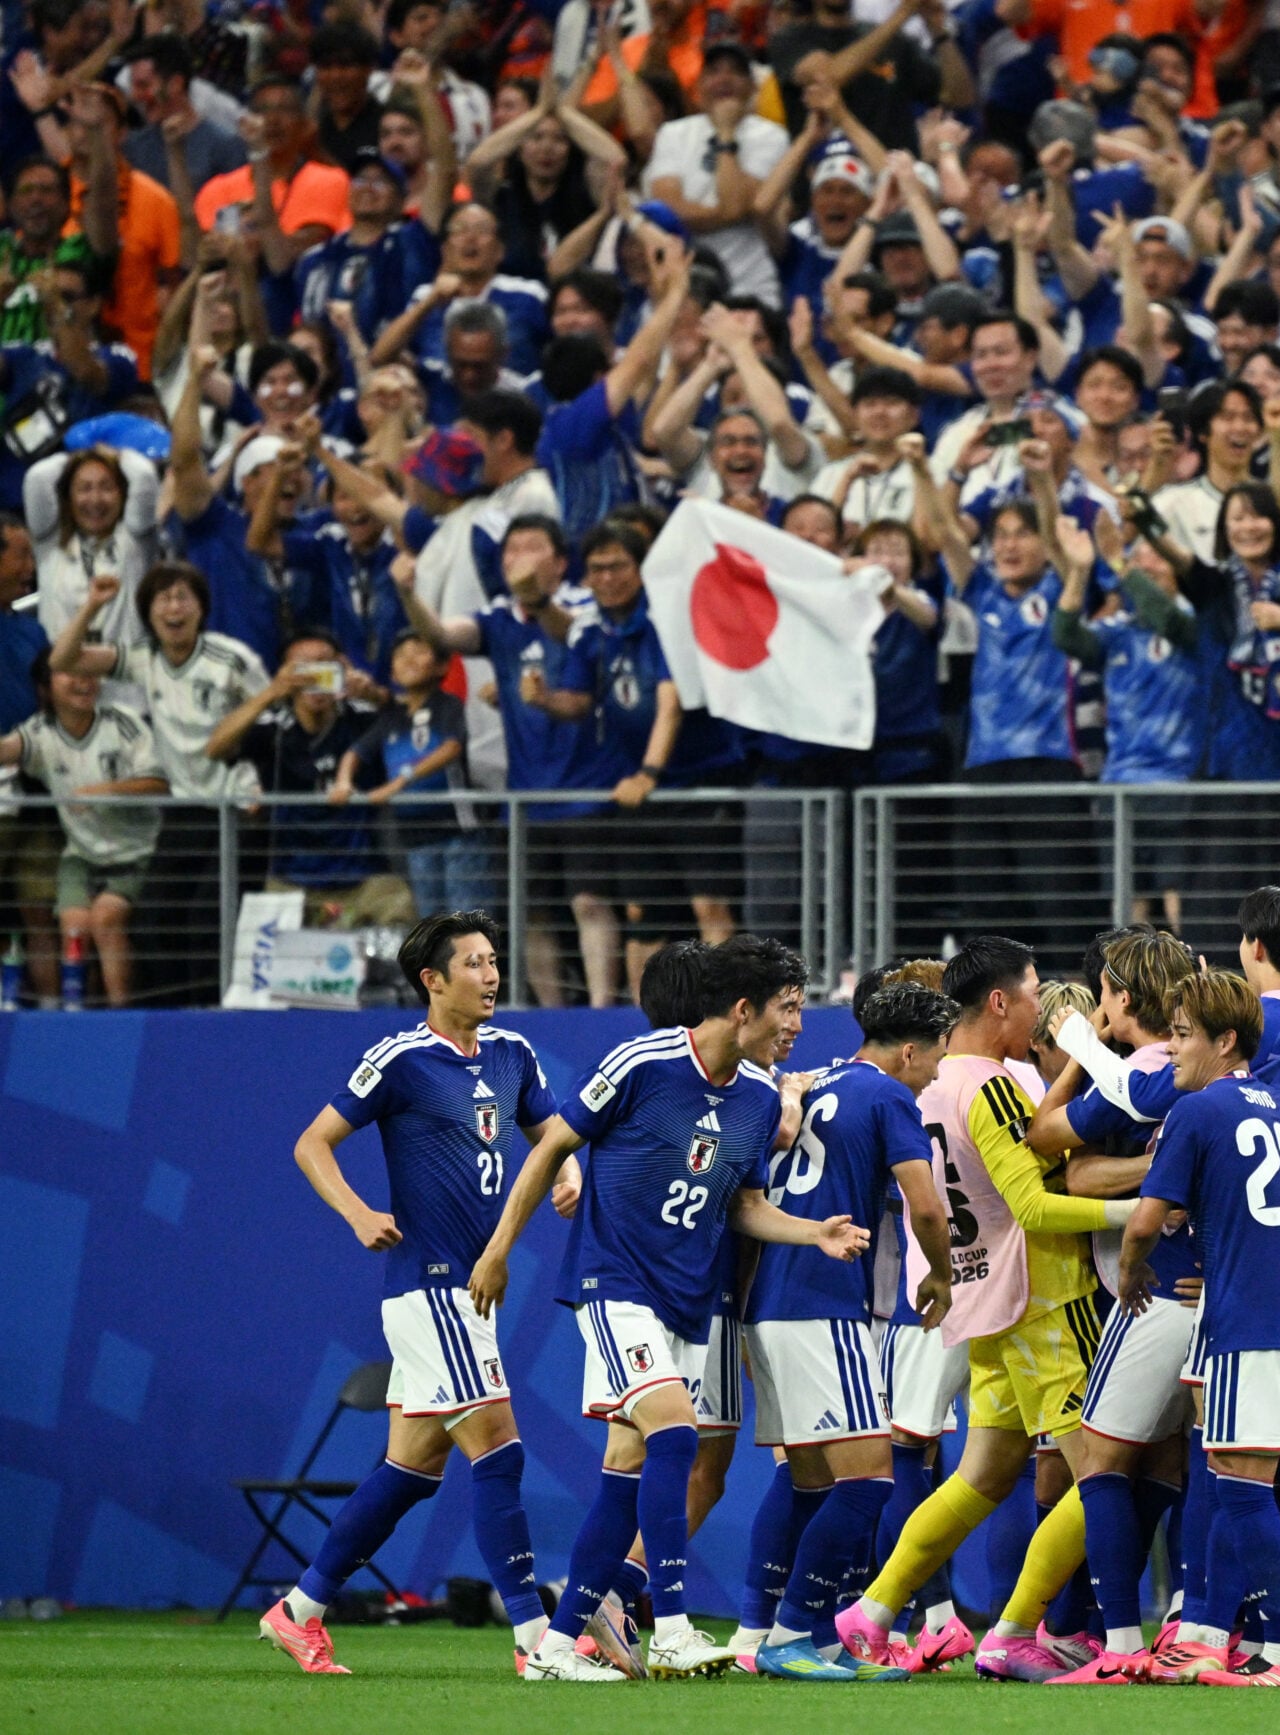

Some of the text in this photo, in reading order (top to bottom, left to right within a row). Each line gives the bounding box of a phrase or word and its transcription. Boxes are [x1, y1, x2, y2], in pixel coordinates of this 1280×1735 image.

[252, 918, 279, 992] VISA
[477, 1151, 504, 1196] 21
[661, 1179, 709, 1230] 22
[964, 1247, 988, 1263] CUP
